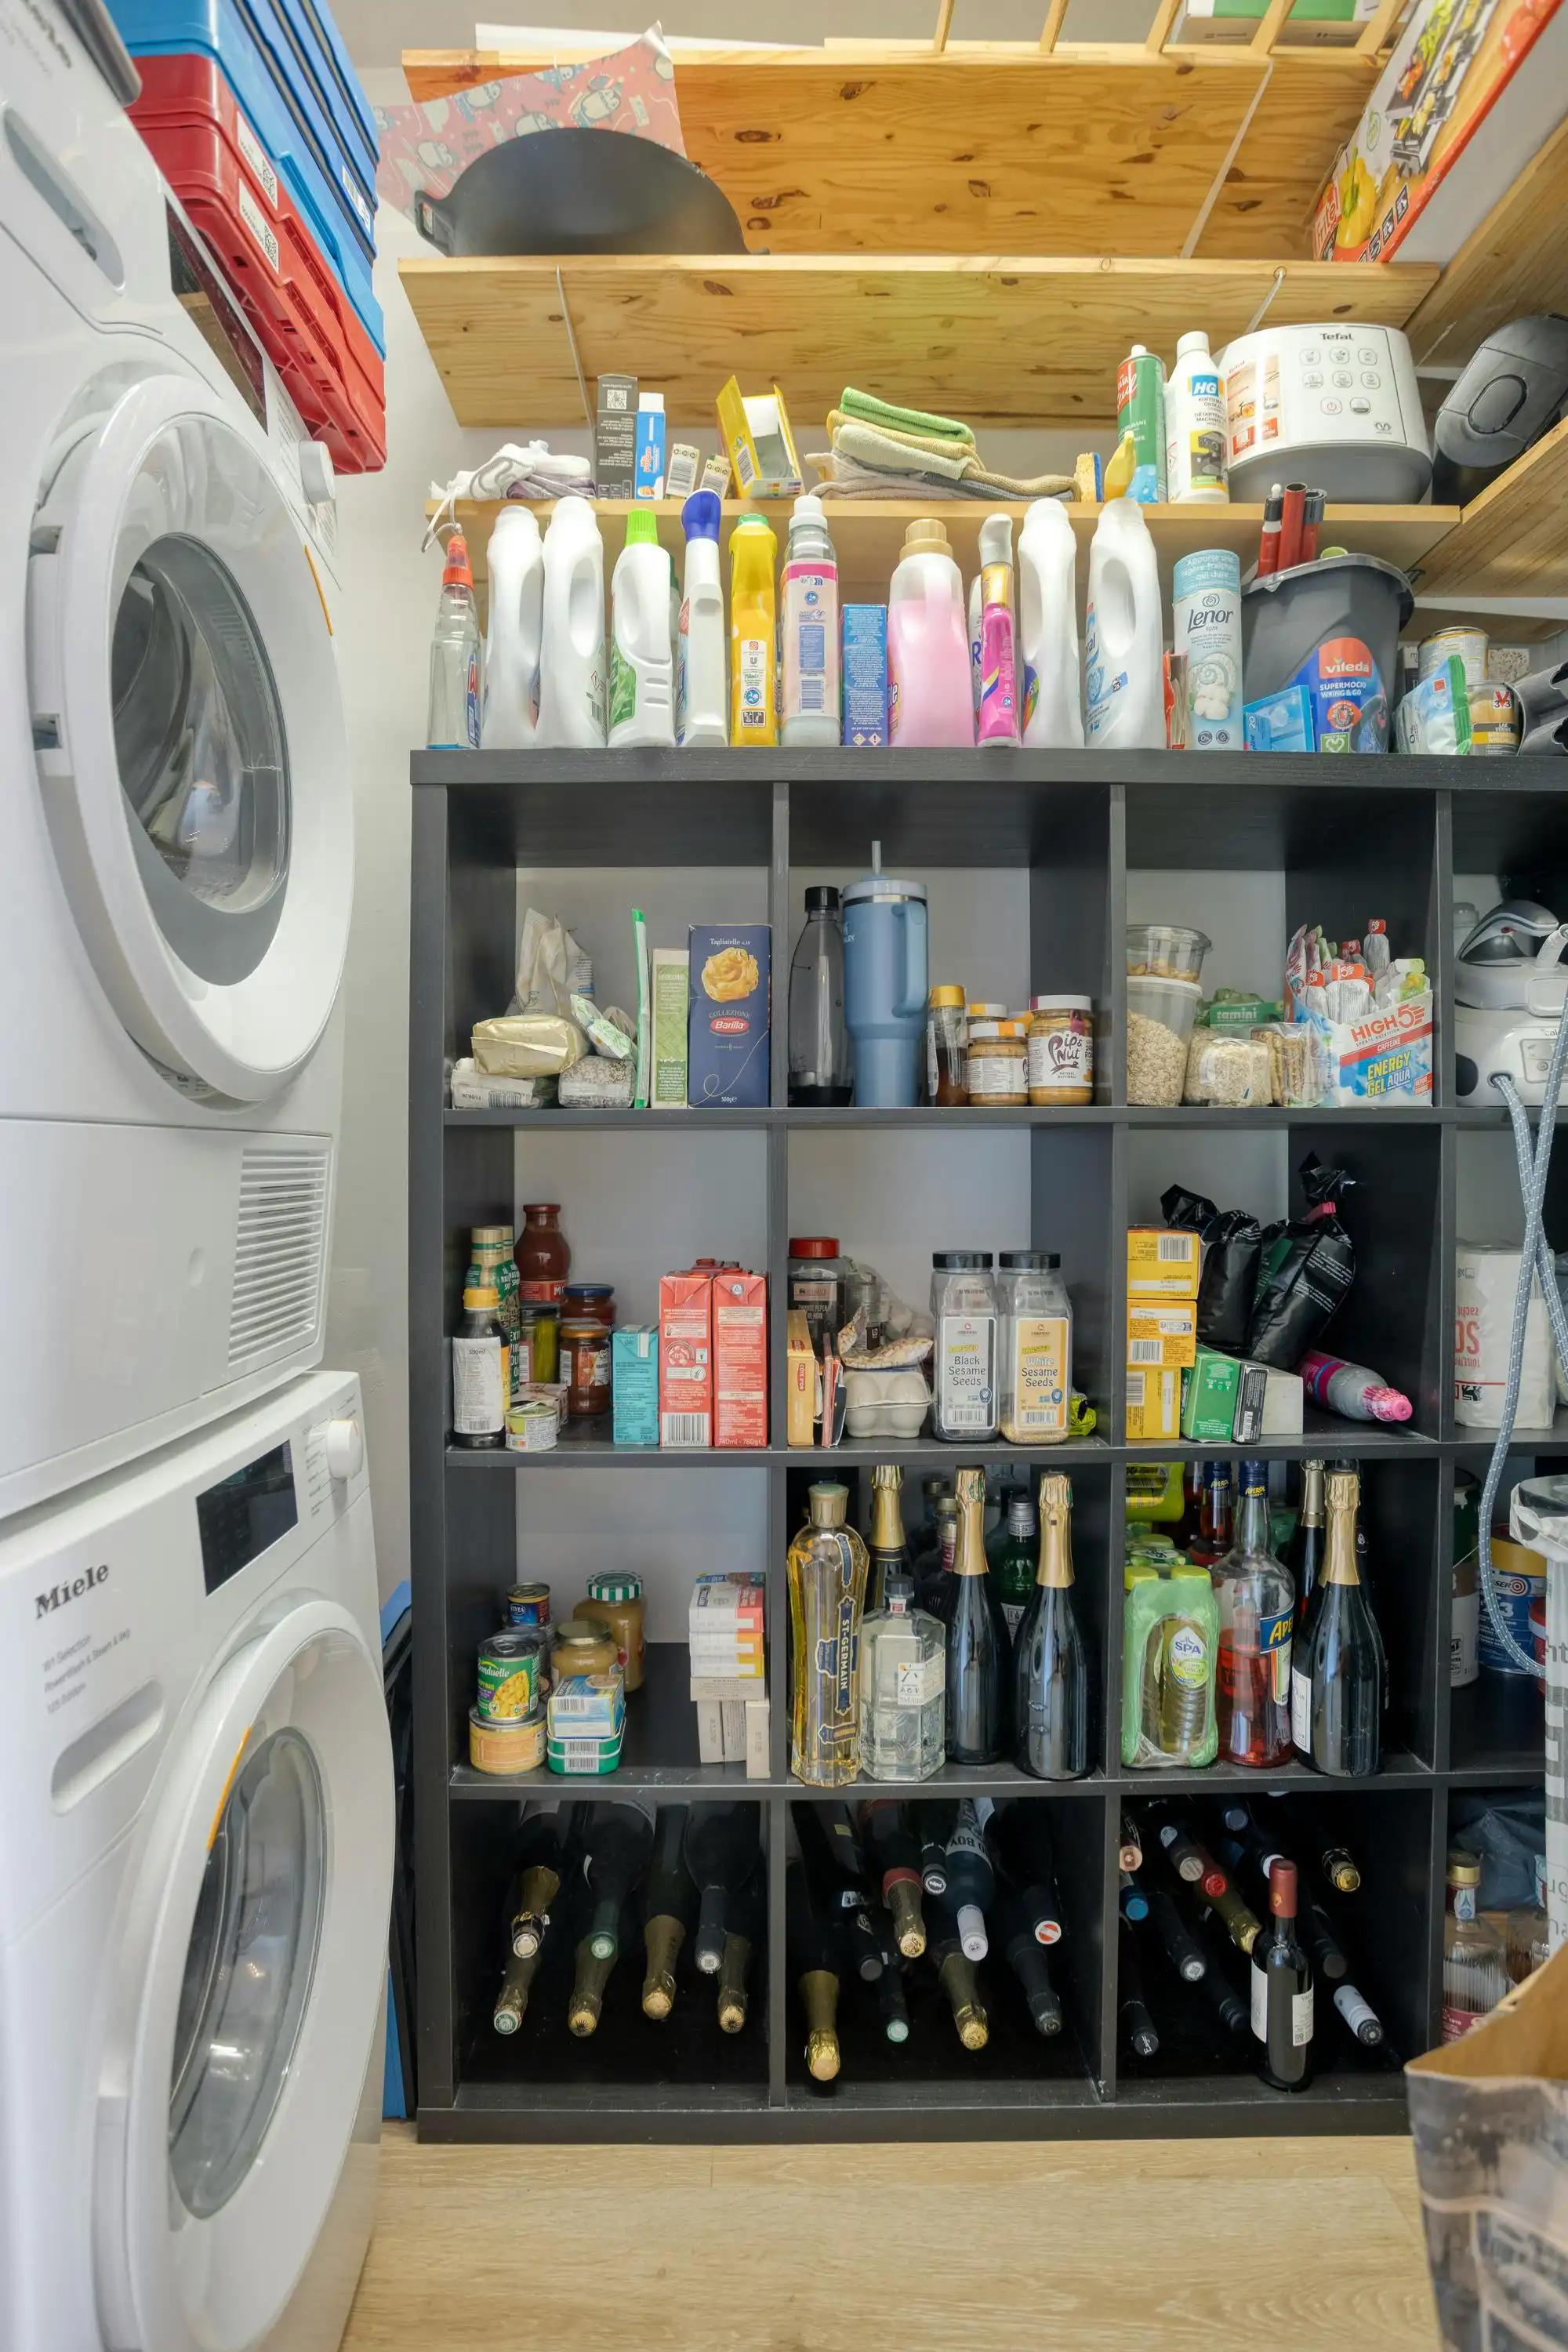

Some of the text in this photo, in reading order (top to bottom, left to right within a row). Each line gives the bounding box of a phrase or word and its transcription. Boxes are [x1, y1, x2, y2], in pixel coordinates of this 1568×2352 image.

[1320, 332, 1354, 341] Tefal
[1193, 382, 1218, 395] HG
[1188, 609, 1234, 633] Lenor
[1324, 659, 1369, 673] vileda
[1319, 681, 1367, 691] SUPERMOCIO
[1320, 690, 1345, 699] WRING
[1248, 716, 1256, 729] 20
[709, 938, 741, 946] Tagliatelle
[709, 1010, 751, 1019] COLLEZIONE
[1377, 1037, 1401, 1052] CAFFEINE
[1058, 1049, 1080, 1063] Nut
[1367, 1050, 1412, 1080] ENERGY
[1367, 1069, 1411, 1098] GEL AQUA
[954, 1356, 980, 1365] Black
[1026, 1357, 1054, 1367] White
[948, 1367, 986, 1375] Sesame
[1022, 1367, 1058, 1377] Sesame
[953, 1377, 982, 1386] Seeds
[1025, 1378, 1054, 1387] Seeds
[35, 1564, 109, 1620] Miele
[1174, 1641, 1201, 1654] SPA
[840, 1619, 850, 1690] ST-GERMAIN
[950, 1835, 975, 1847] BOY
